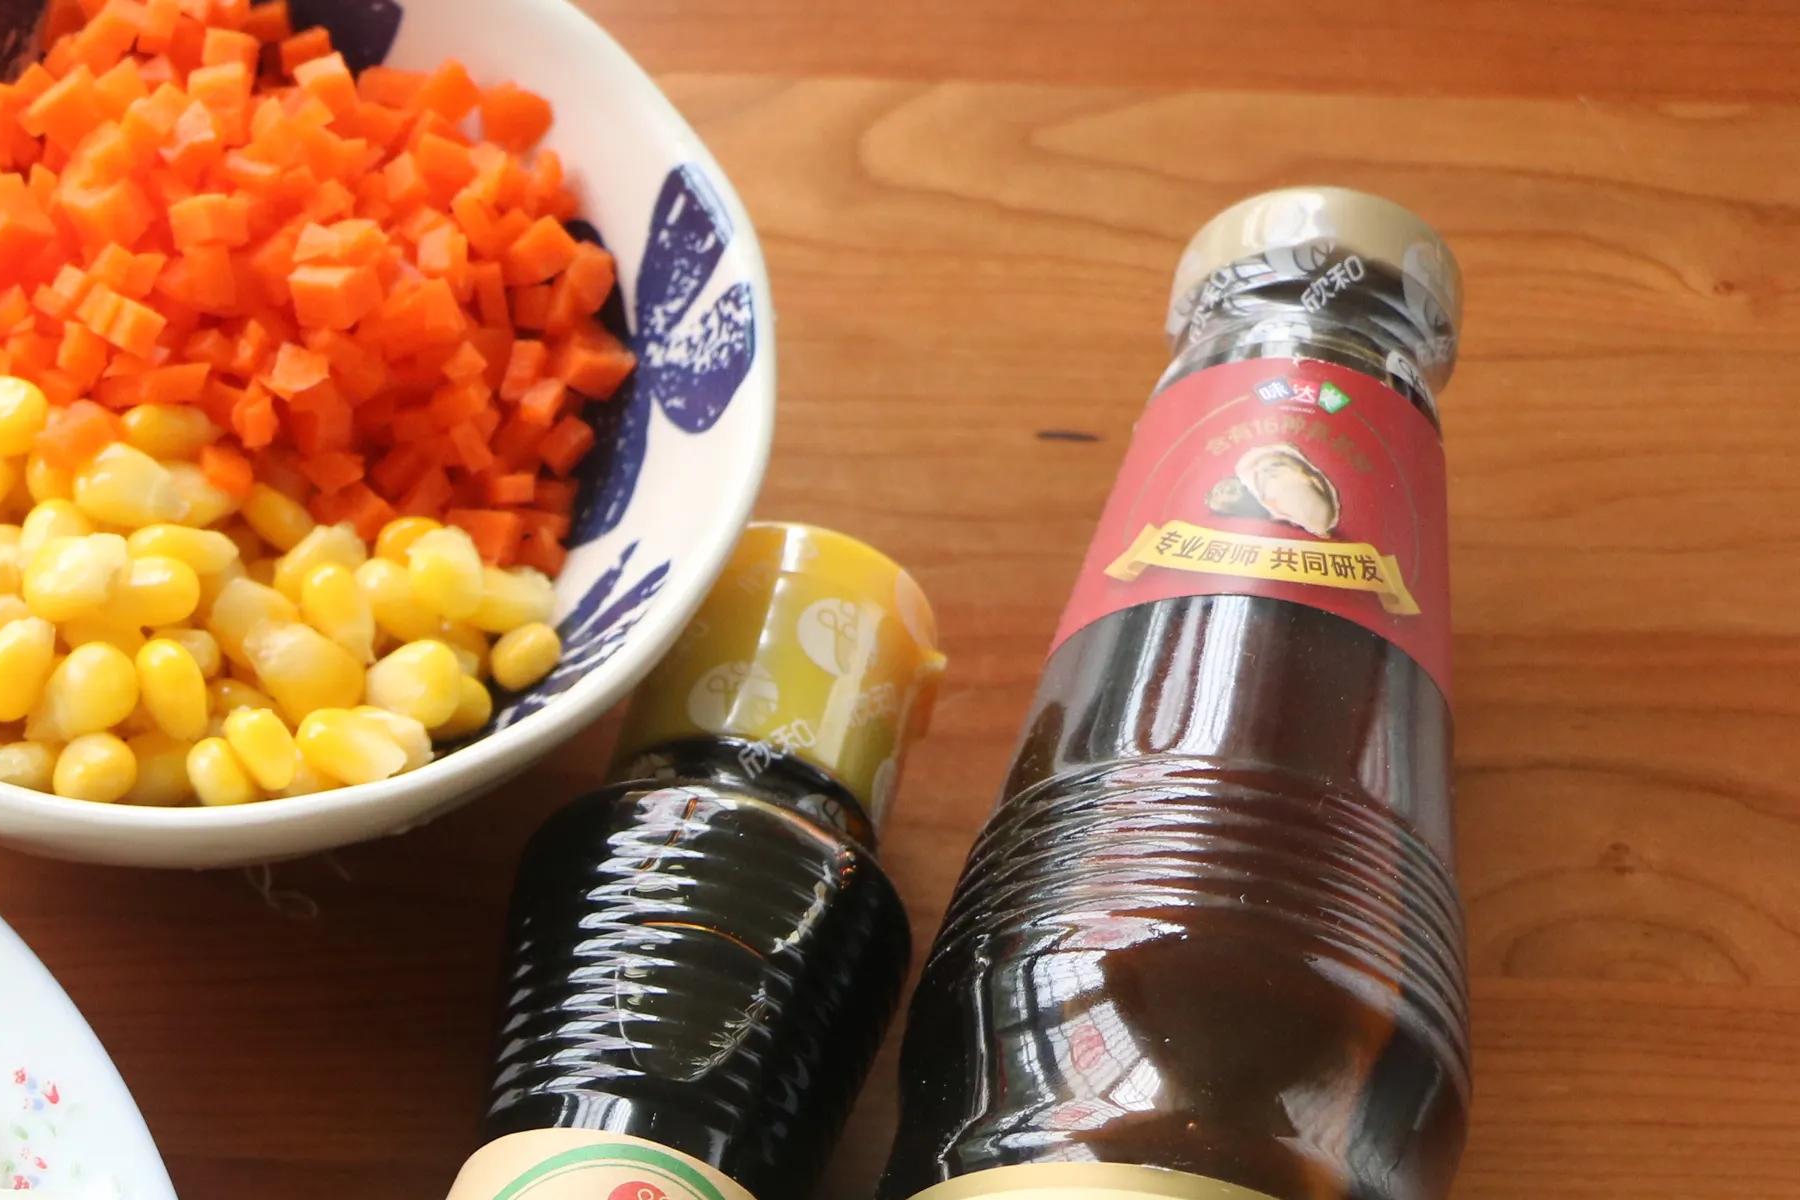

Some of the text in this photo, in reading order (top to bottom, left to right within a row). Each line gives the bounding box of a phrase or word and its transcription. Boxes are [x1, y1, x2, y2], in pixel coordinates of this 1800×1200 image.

[1301, 255, 1365, 313] 欣和
[1154, 530, 1384, 583] 专业厨师 共同研发
[738, 719, 816, 779] 欣和
